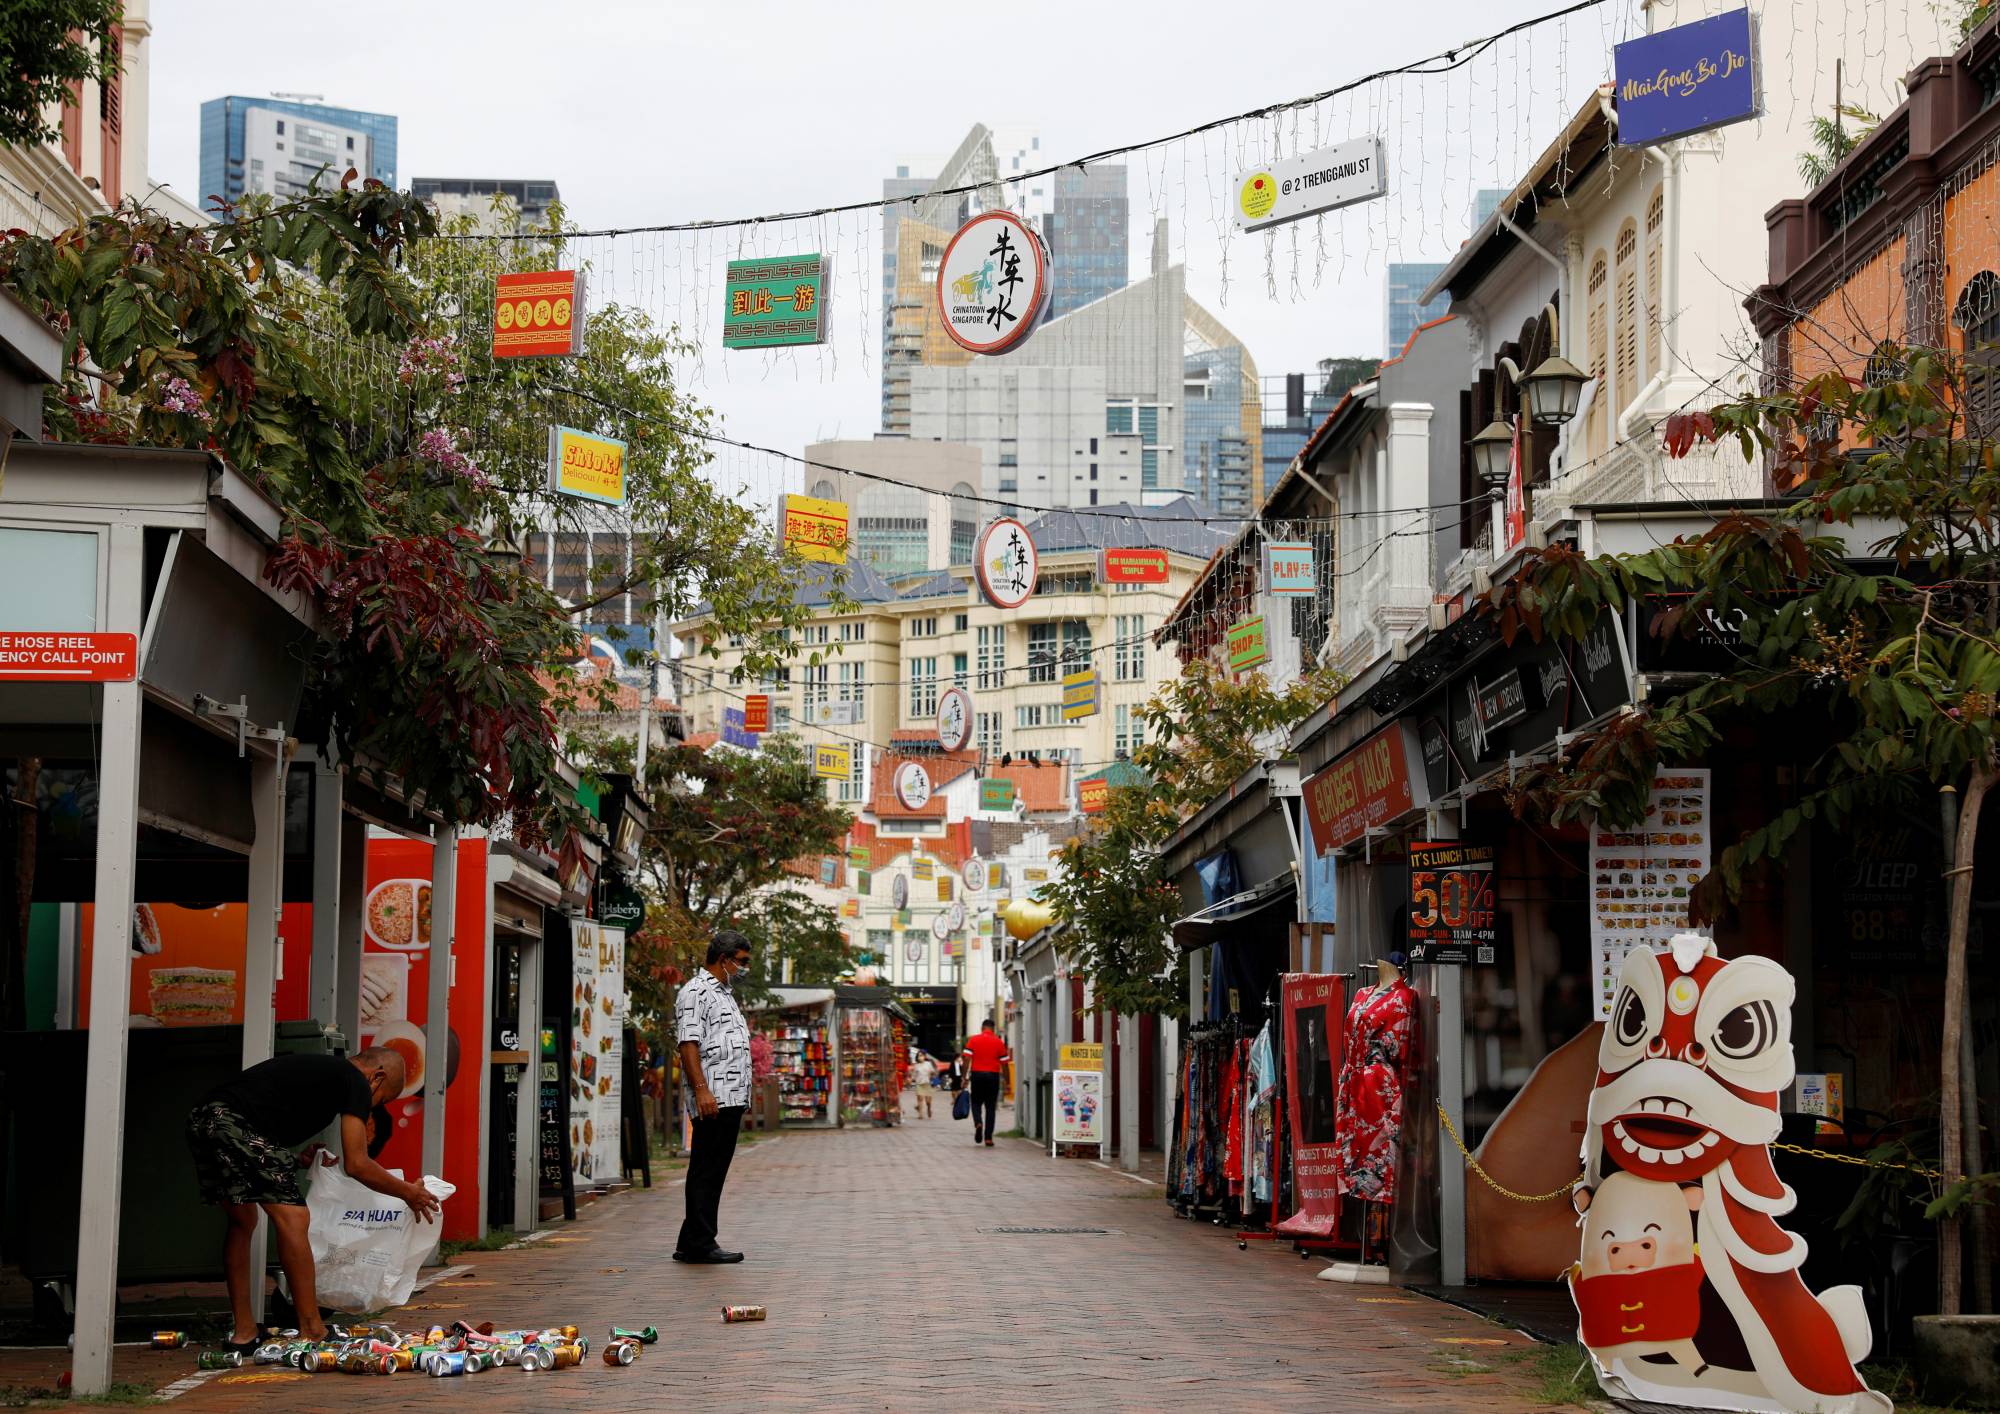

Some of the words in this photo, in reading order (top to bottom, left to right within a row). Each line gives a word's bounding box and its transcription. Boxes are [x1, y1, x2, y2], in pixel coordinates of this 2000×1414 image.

[1623, 78, 1651, 101] Mai
[1651, 69, 1696, 97] Gong
[1696, 57, 1717, 83] Bo
[1720, 49, 1745, 78] Jio
[1281, 179, 1293, 195] @
[1294, 177, 1301, 192] 2
[1303, 161, 1357, 189] TRENGGANU
[1358, 157, 1370, 173] ST
[986, 225, 1024, 332] 牛车水
[732, 283, 814, 316] 到此一游
[500, 303, 567, 322] 吃喝玩乐
[952, 305, 985, 314] CHINATOWN
[952, 315, 984, 324] SINGAPORE
[565, 445, 621, 476] Shiok!
[1008, 527, 1029, 595] 牛车水
[1273, 561, 1299, 578] PLAY
[1122, 567, 1145, 575] TEMPLE
[15, 637, 54, 648] HOSE
[58, 637, 95, 649] REEL
[1231, 634, 1253, 657] SHOP
[42, 652, 78, 663] CALL
[82, 653, 125, 663] POINT
[818, 753, 838, 768] EAT
[1314, 759, 1360, 824] EUROBEST
[1355, 738, 1395, 800] TAILOR
[1411, 850, 1430, 868] IT'S
[1431, 849, 1461, 865] LUNCH
[1469, 911, 1494, 928] OFF
[342, 1210, 364, 1221] SIA
[368, 1209, 402, 1222] HUAT
